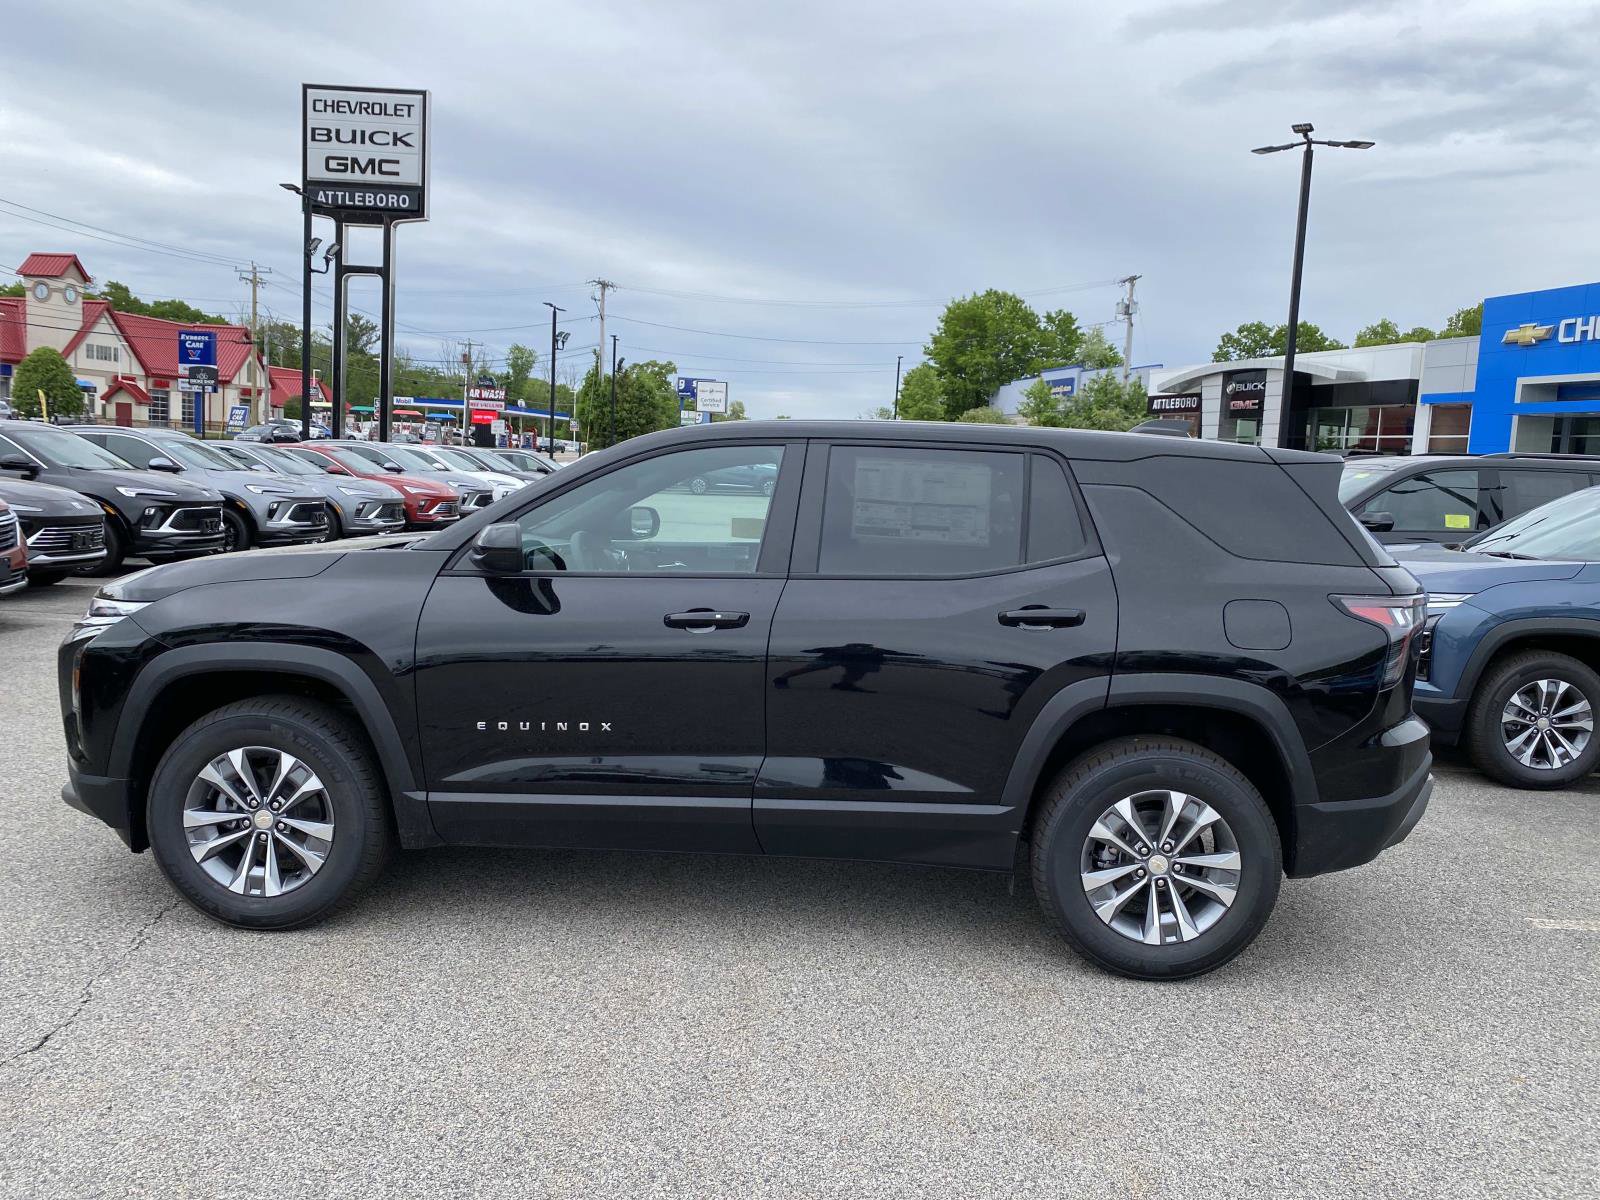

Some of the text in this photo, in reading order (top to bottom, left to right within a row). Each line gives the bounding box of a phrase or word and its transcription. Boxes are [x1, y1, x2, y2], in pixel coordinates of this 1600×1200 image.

[312, 99, 415, 118] CHEVROLET
[310, 127, 415, 148] BUICK
[325, 155, 400, 177] GMC
[317, 190, 409, 208] ATTLEBORO
[1558, 315, 1600, 343] CH
[185, 340, 204, 349] CARE
[469, 388, 506, 399] AR WASH
[1235, 381, 1266, 392] BUICK
[1152, 396, 1198, 410] ATTLEBORO
[1230, 399, 1259, 410] GMC
[476, 721, 612, 732] EQUINOX
